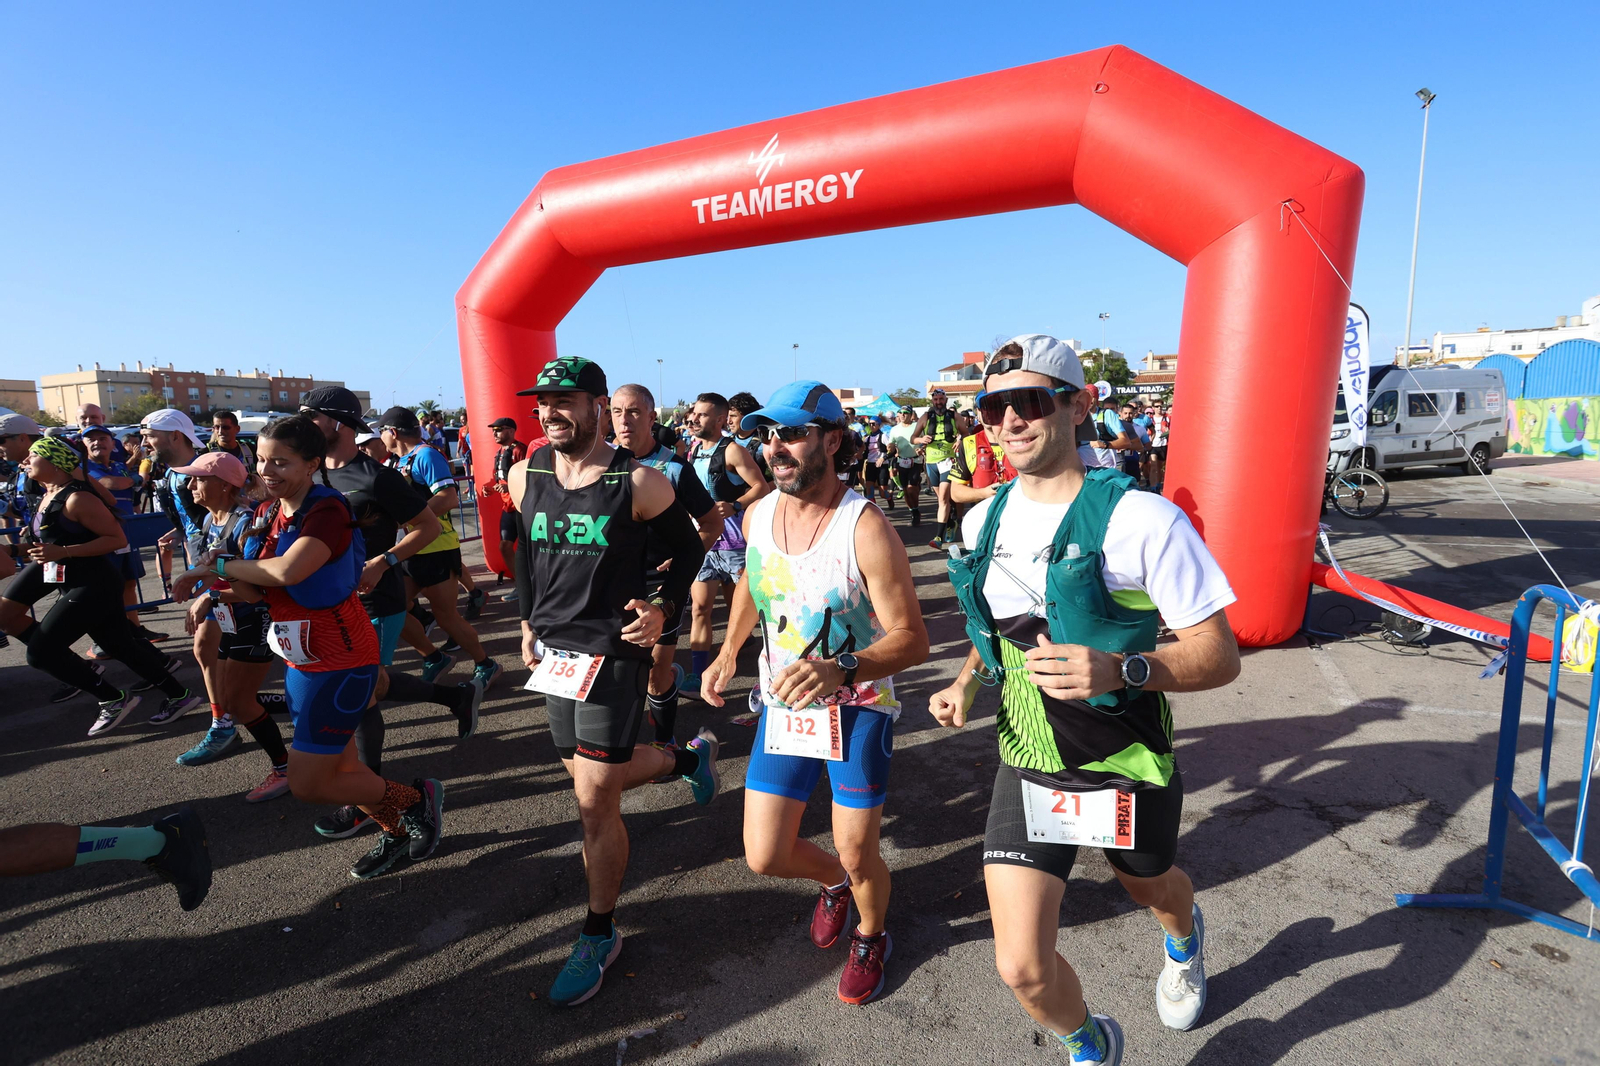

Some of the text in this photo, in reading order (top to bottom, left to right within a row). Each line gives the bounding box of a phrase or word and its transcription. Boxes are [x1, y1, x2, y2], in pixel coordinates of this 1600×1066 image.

[692, 169, 864, 224] TEAMERGY
[1116, 386, 1138, 394] TRAIL
[260, 613, 270, 645] WONG
[277, 637, 292, 651] 90
[548, 661, 577, 678] 136
[580, 657, 602, 693] PIRATA
[785, 715, 817, 736] 132
[829, 709, 840, 751] PIRATA
[1051, 790, 1081, 816] 21
[94, 837, 118, 851] NIKE
